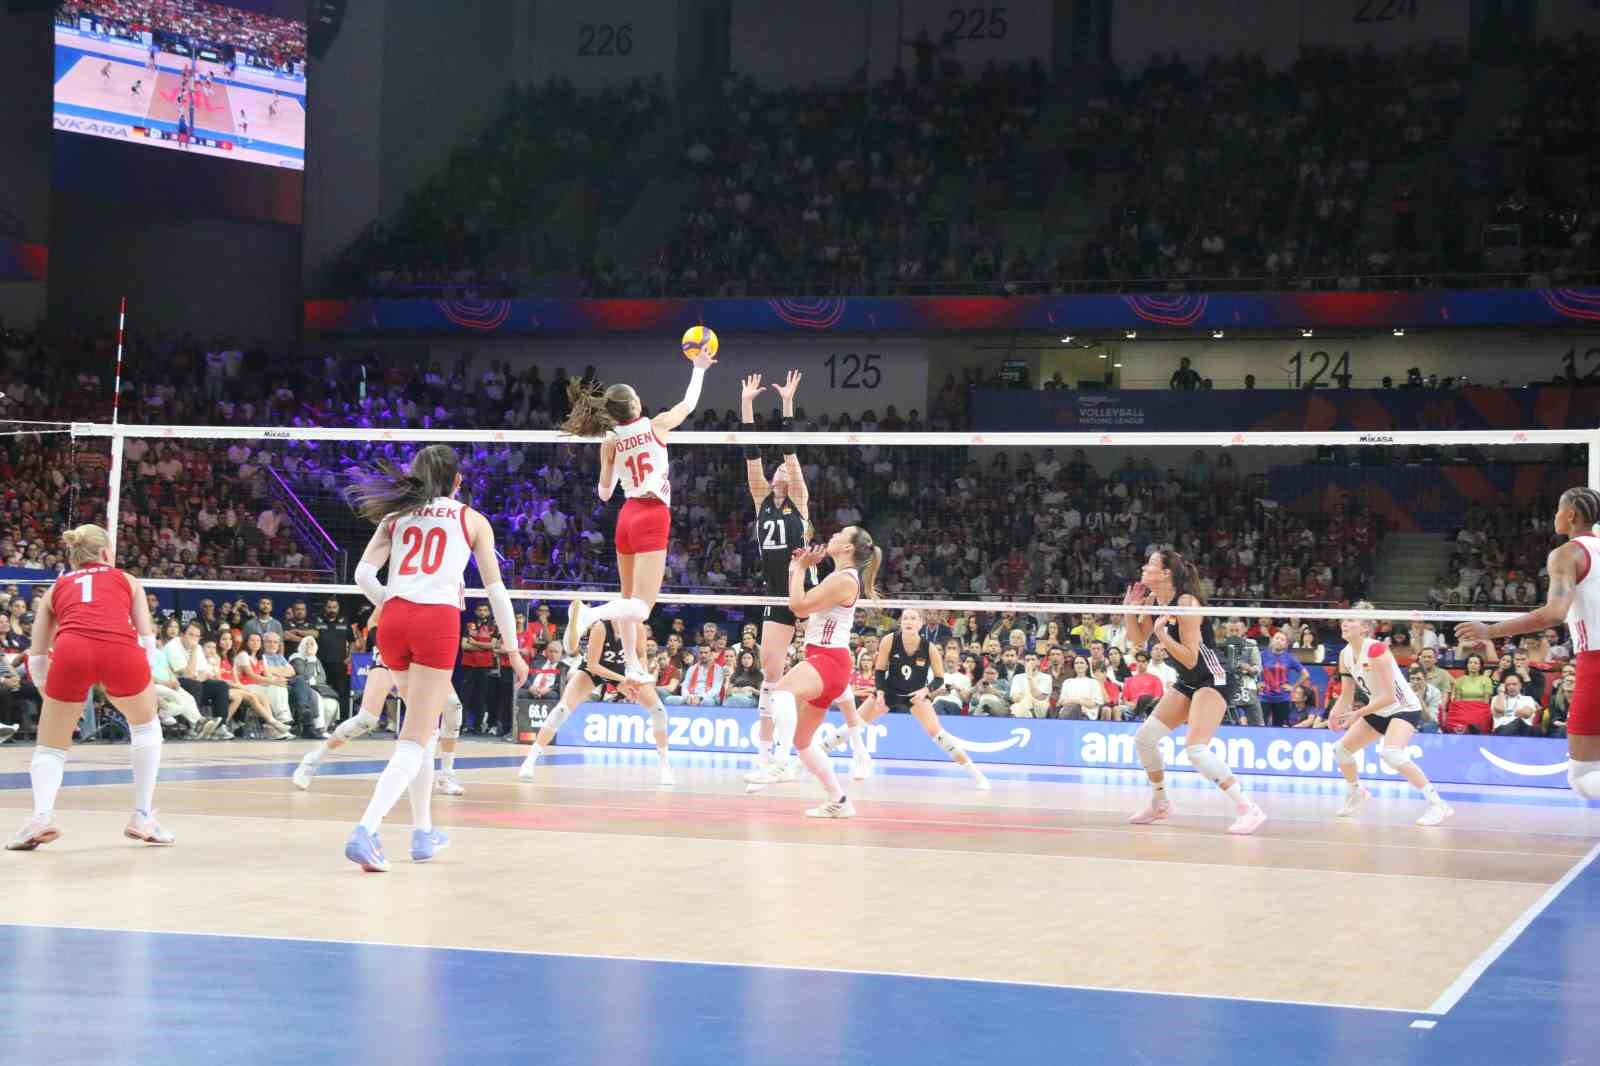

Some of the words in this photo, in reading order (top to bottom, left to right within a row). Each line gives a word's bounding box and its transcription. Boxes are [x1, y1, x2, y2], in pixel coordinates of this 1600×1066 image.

[578, 24, 633, 56] 226
[948, 8, 1007, 40] 225
[824, 353, 881, 389] 125
[1289, 351, 1352, 389] 124
[1079, 408, 1144, 417] VOLLEYBALL
[412, 506, 458, 519] RKEK
[762, 519, 786, 546] 21
[399, 526, 447, 575] 20
[74, 574, 93, 602] 1
[901, 665, 912, 681] 9
[583, 713, 888, 753] amzon..r
